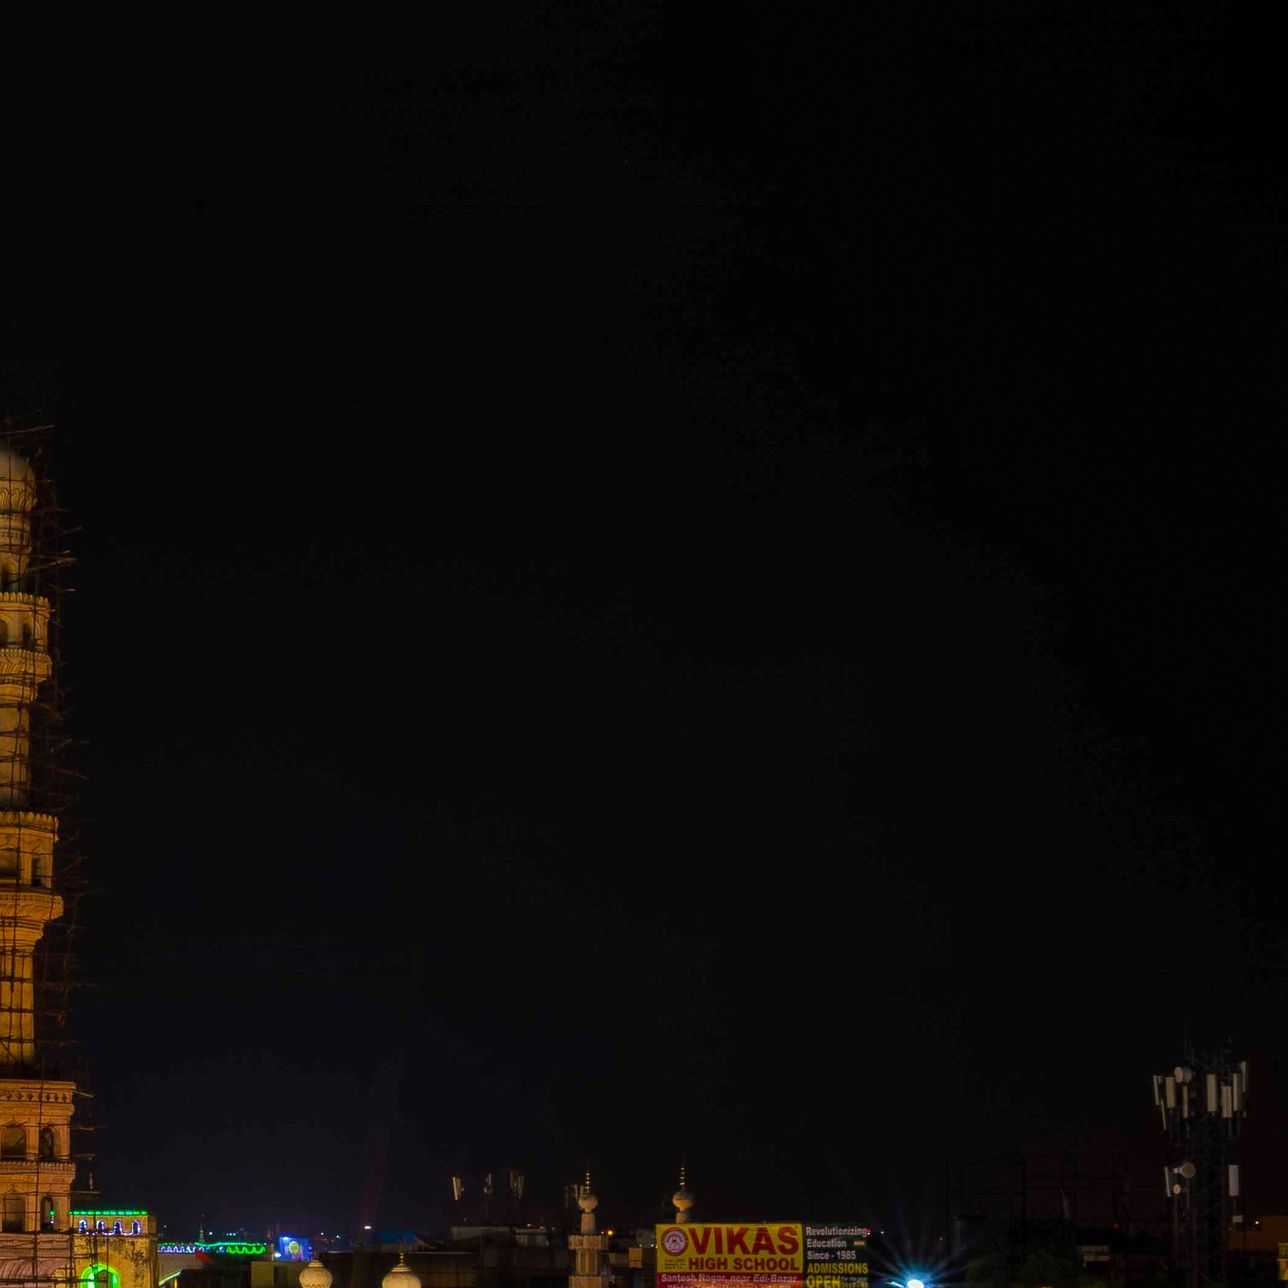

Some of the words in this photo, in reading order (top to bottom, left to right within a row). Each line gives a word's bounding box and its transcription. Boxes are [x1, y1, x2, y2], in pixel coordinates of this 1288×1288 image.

[689, 1226, 800, 1255] VIKAS
[806, 1239, 847, 1248] Education
[808, 1251, 830, 1260] Since
[688, 1258, 727, 1271] HIGH
[734, 1258, 800, 1271] SCHOOL
[808, 1263, 868, 1274] ADMISSIONS
[807, 1276, 840, 1288] OPEN
